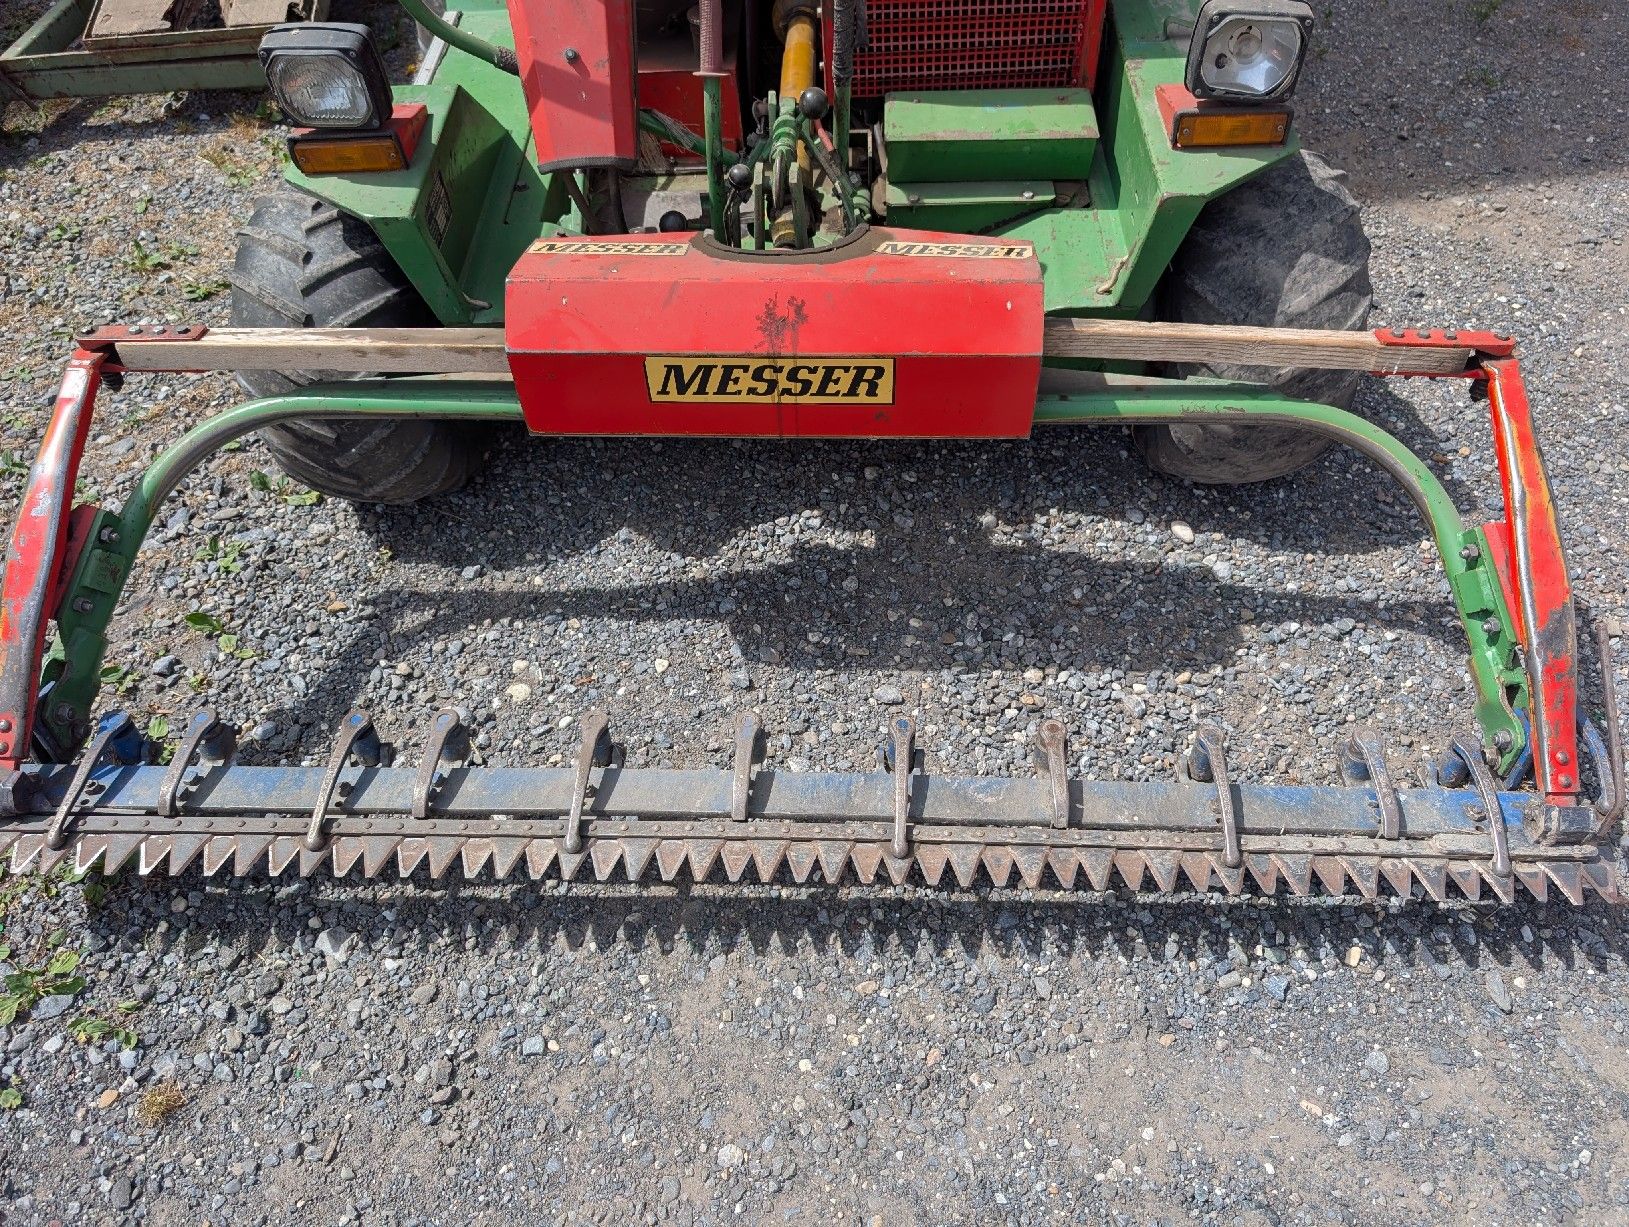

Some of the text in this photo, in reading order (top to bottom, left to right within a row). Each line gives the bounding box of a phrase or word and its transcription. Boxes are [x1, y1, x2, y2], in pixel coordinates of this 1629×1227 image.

[533, 243, 684, 254] MESSER
[883, 243, 1028, 257] MESSER
[656, 364, 886, 397] MESSER
